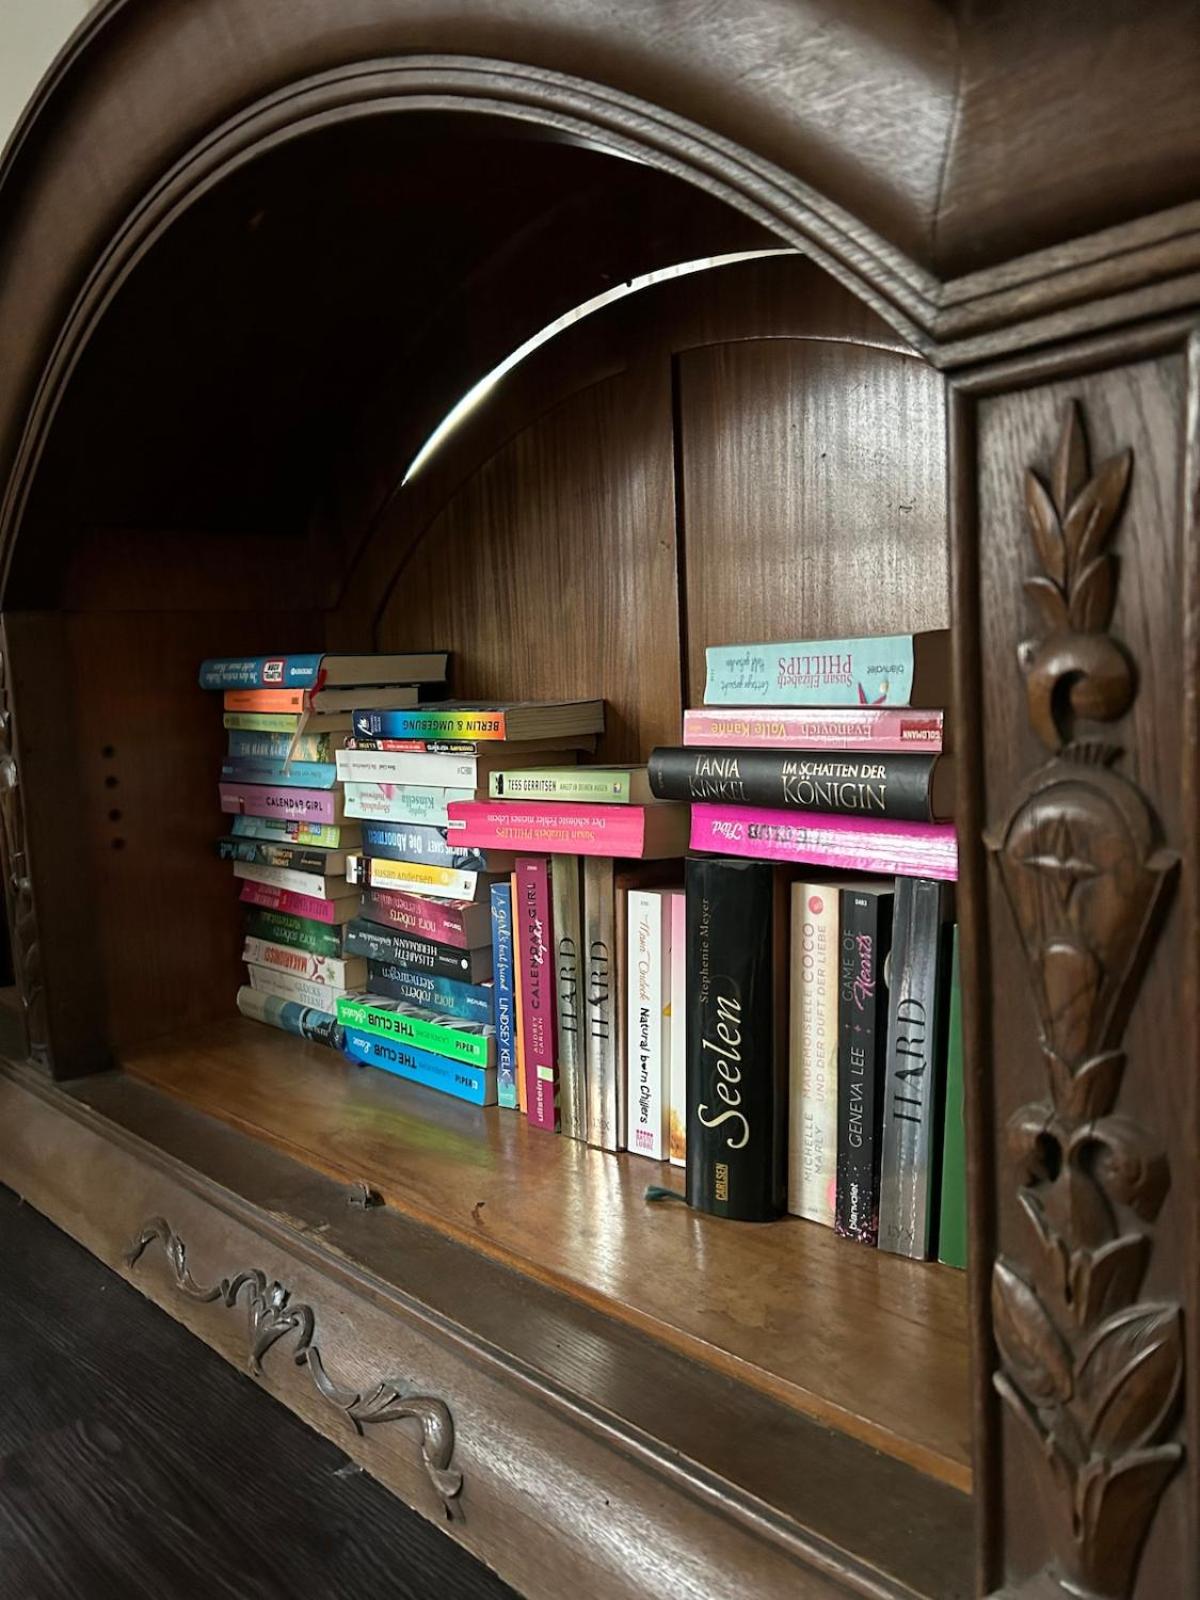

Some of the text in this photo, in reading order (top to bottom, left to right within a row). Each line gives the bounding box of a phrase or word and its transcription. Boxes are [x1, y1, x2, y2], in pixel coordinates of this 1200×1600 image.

[778, 654, 853, 675] PHILLIPS
[776, 672, 854, 690] Susan Elizabeth
[402, 718, 500, 732] BERLIN & UMGEBUNG
[711, 720, 787, 738] Volle Kanne
[800, 721, 872, 738] Evanovich
[901, 728, 941, 741] GOLDMANN
[695, 755, 740, 779] TANIA
[782, 760, 888, 780] IM SCHATTEN DER
[508, 778, 558, 792] TESS GERRITSEN
[688, 774, 750, 801] KINKEL
[782, 773, 888, 811] KÖNIGIN
[305, 800, 324, 812] GIRL
[401, 793, 435, 810] Kinsella
[487, 813, 511, 825] Lebens
[711, 820, 744, 841] Flirt
[408, 834, 423, 854] Die
[495, 826, 534, 840] PHILLIPS
[570, 829, 596, 841] Susan
[389, 908, 436, 932] nora roberts
[392, 936, 438, 956] HERRMANN
[394, 947, 434, 967] ELISABETH
[526, 883, 542, 1010] CALENDAR GIRL
[699, 898, 712, 1004] Stephenie Meyer
[841, 927, 855, 1002] GAME OF
[852, 931, 877, 1011] Hearts
[400, 985, 454, 1008] nora roberts
[801, 922, 815, 1099] MADEMOISELLE COCO
[815, 924, 828, 1102] UND DER DUFT DER LIEBE
[367, 1012, 415, 1037] THE CLUB
[639, 1006, 651, 1052] Natural
[455, 1040, 475, 1053] PIPER
[498, 997, 511, 1077] LINDSEY KELK
[374, 1043, 398, 1064] CLUB
[398, 1054, 418, 1070] THE
[892, 998, 927, 1124] HARD
[455, 1074, 473, 1088] PIPER
[697, 996, 750, 1149] Seelen
[535, 1079, 544, 1122] ullstein
[639, 1084, 652, 1125] Chillers
[848, 1046, 865, 1148] GENEVA LEE
[803, 1111, 814, 1183] MICHELLE
[814, 1126, 824, 1177] MARLY
[715, 1162, 729, 1202] CARLSEN
[848, 1182, 860, 1232] blanvalet
